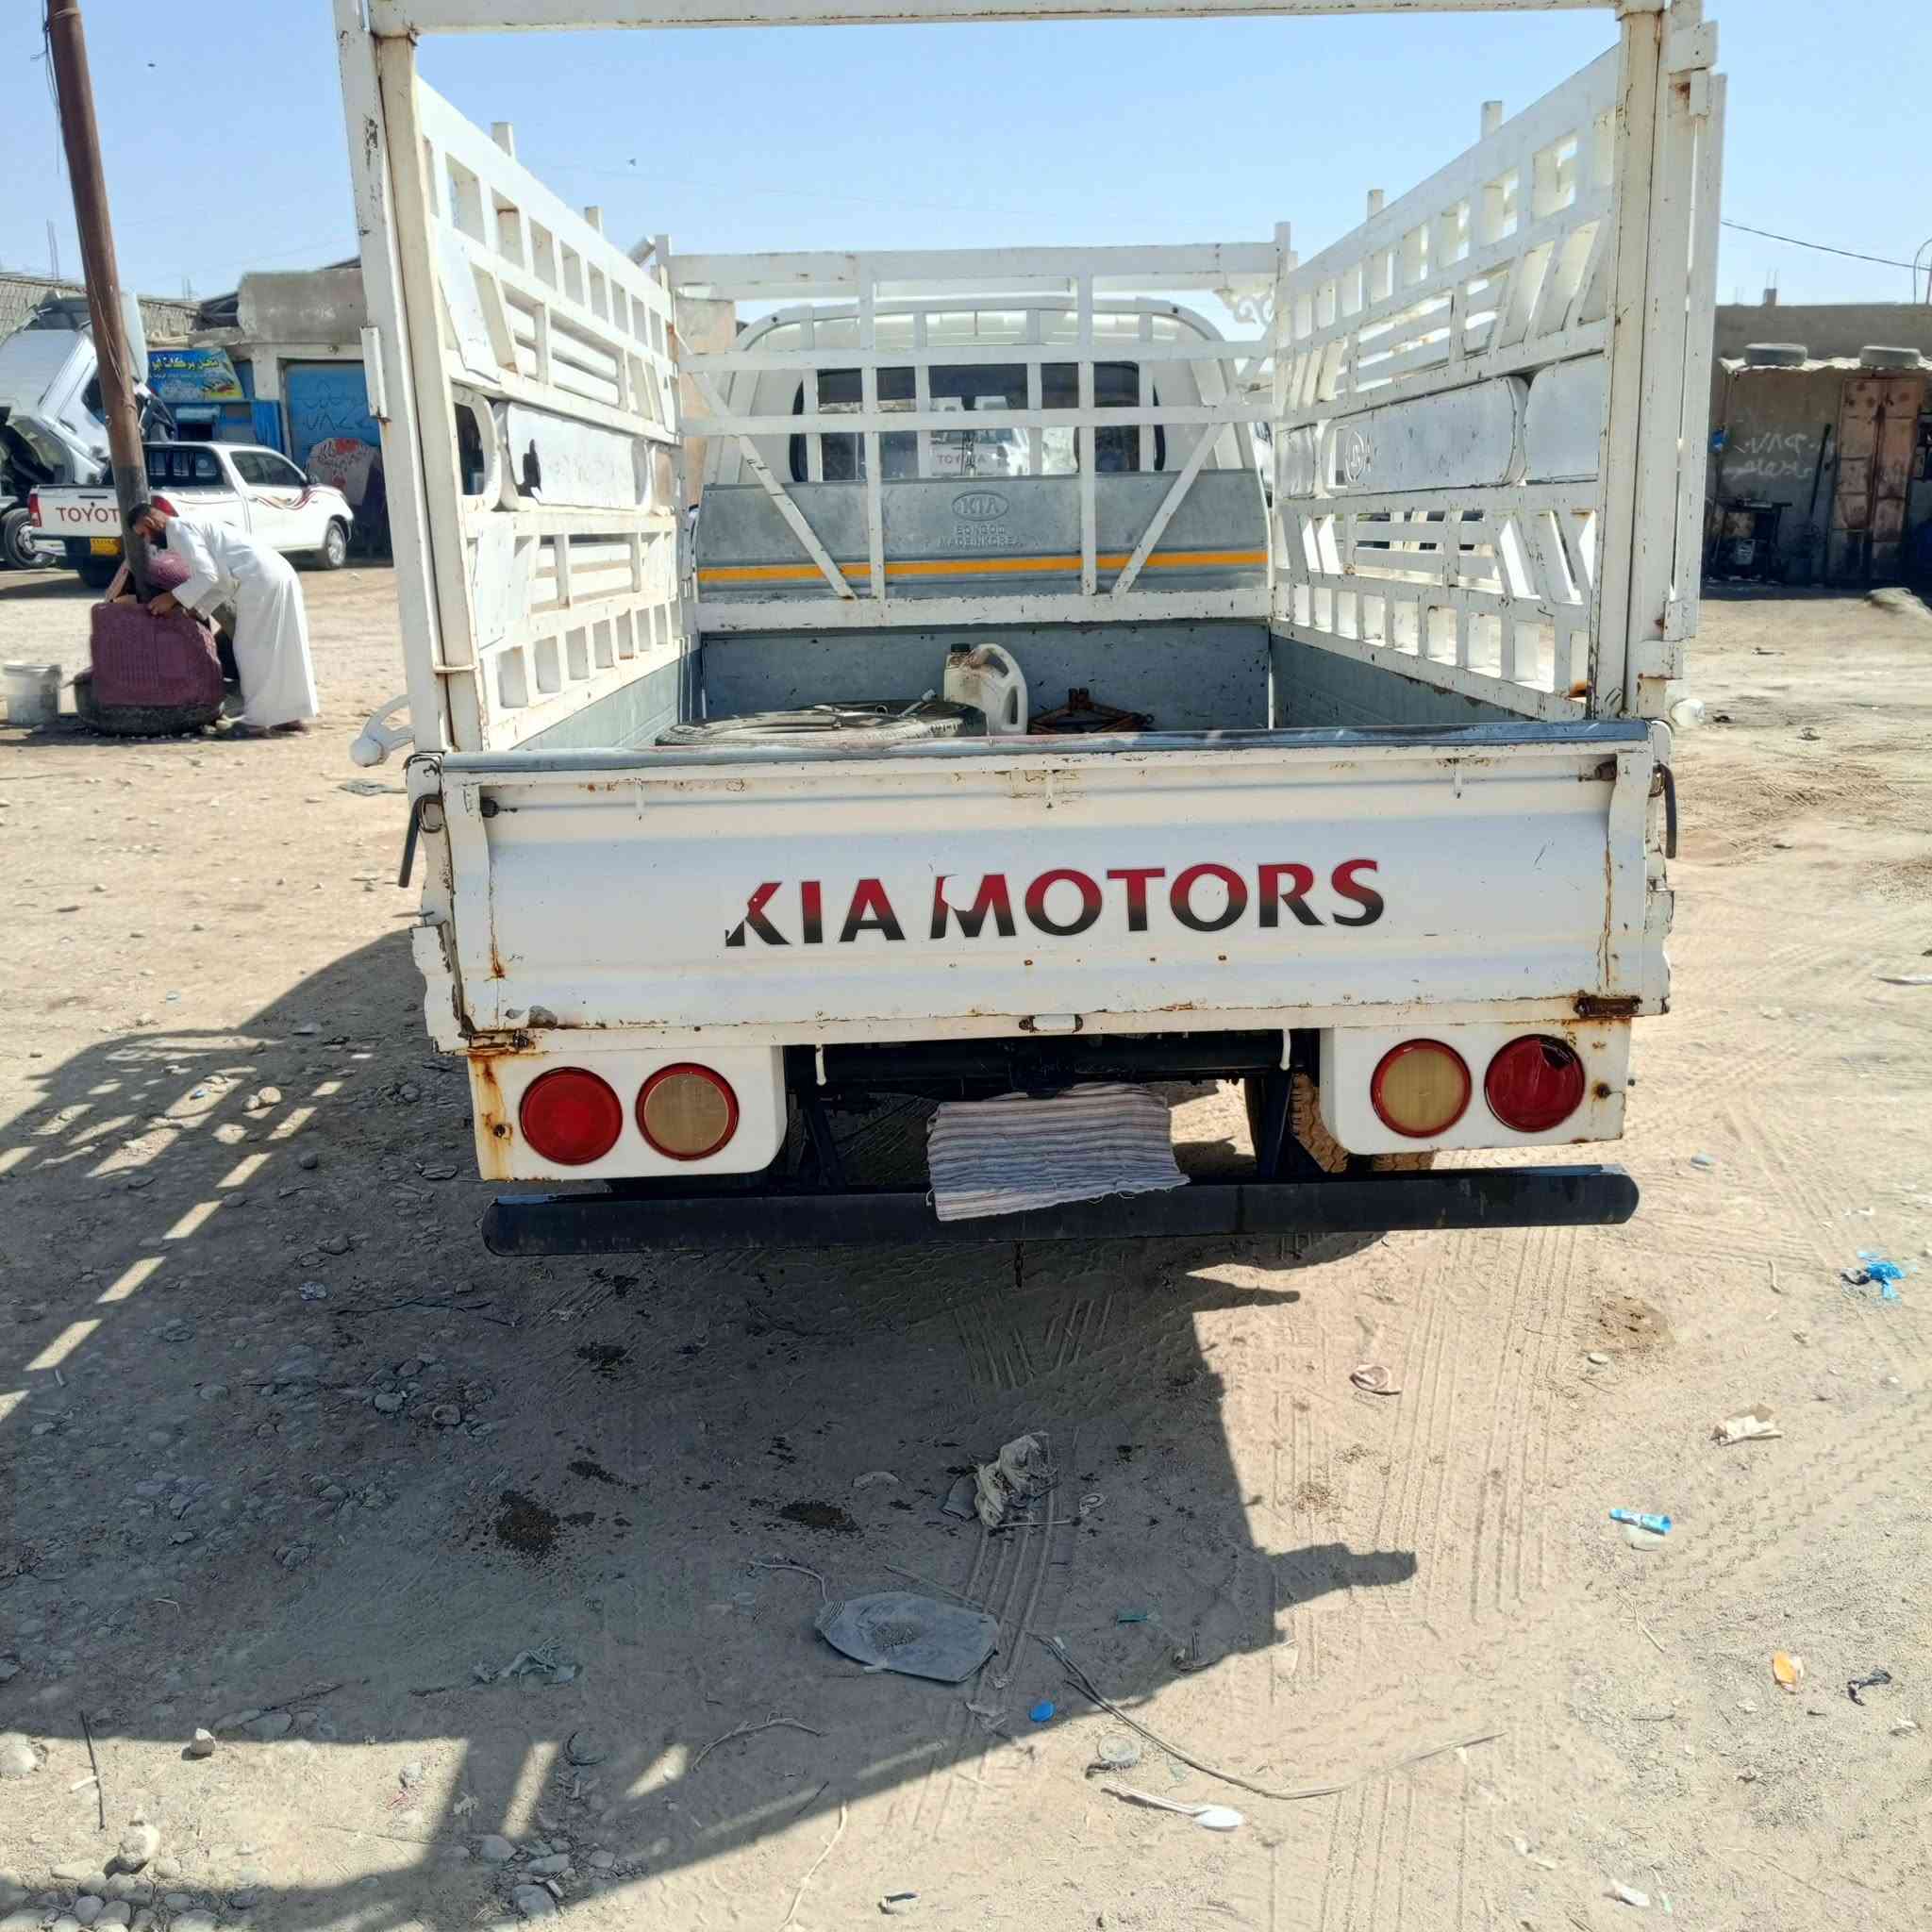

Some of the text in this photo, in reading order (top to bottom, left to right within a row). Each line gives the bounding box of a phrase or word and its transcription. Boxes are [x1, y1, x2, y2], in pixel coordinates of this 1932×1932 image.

[55, 507, 121, 523] TOYOT
[725, 858, 1386, 947] KIA MOTORS
